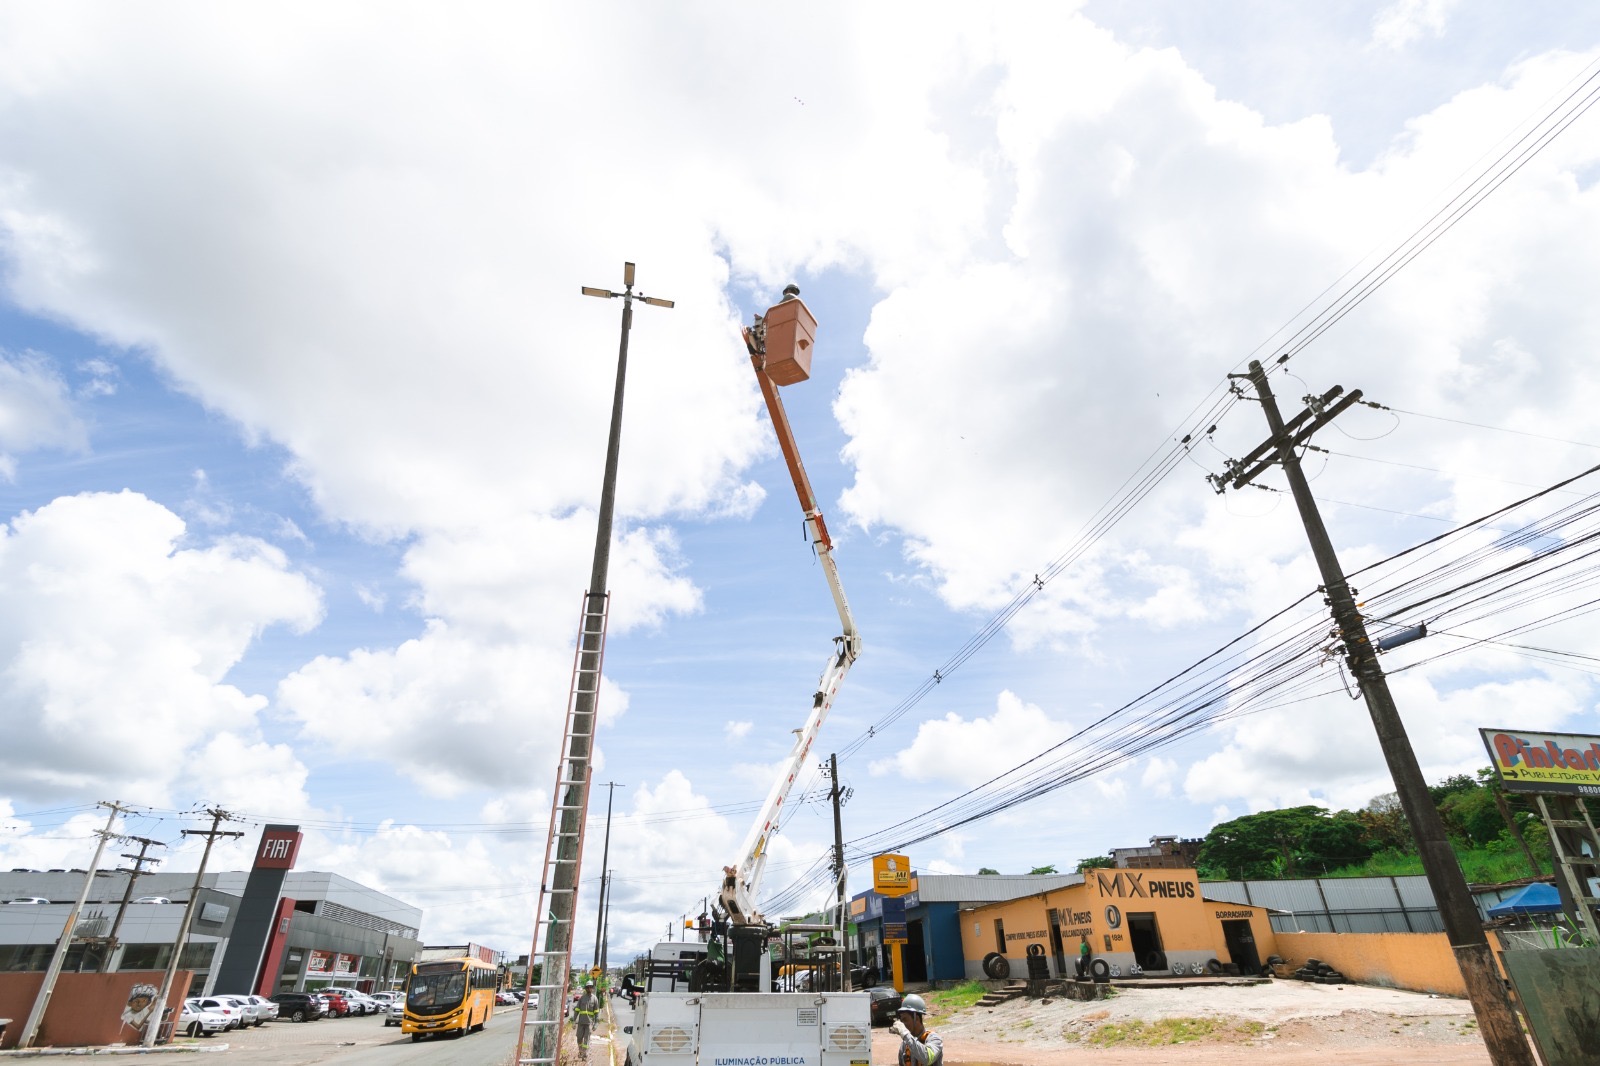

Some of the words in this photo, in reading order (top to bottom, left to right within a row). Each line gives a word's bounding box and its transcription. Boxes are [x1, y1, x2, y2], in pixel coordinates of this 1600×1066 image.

[1520, 768, 1591, 781] PUBLICIDADE
[262, 839, 293, 858] FIAT
[1097, 872, 1148, 898] MX
[1148, 880, 1195, 898] PNEUS
[1058, 907, 1074, 927] MX
[1073, 911, 1091, 925] PNEUS
[1215, 910, 1254, 919] BORRACHARIA
[714, 1055, 769, 1066] ILUMINAÇÃO
[770, 1055, 805, 1066] PÚBLICA
